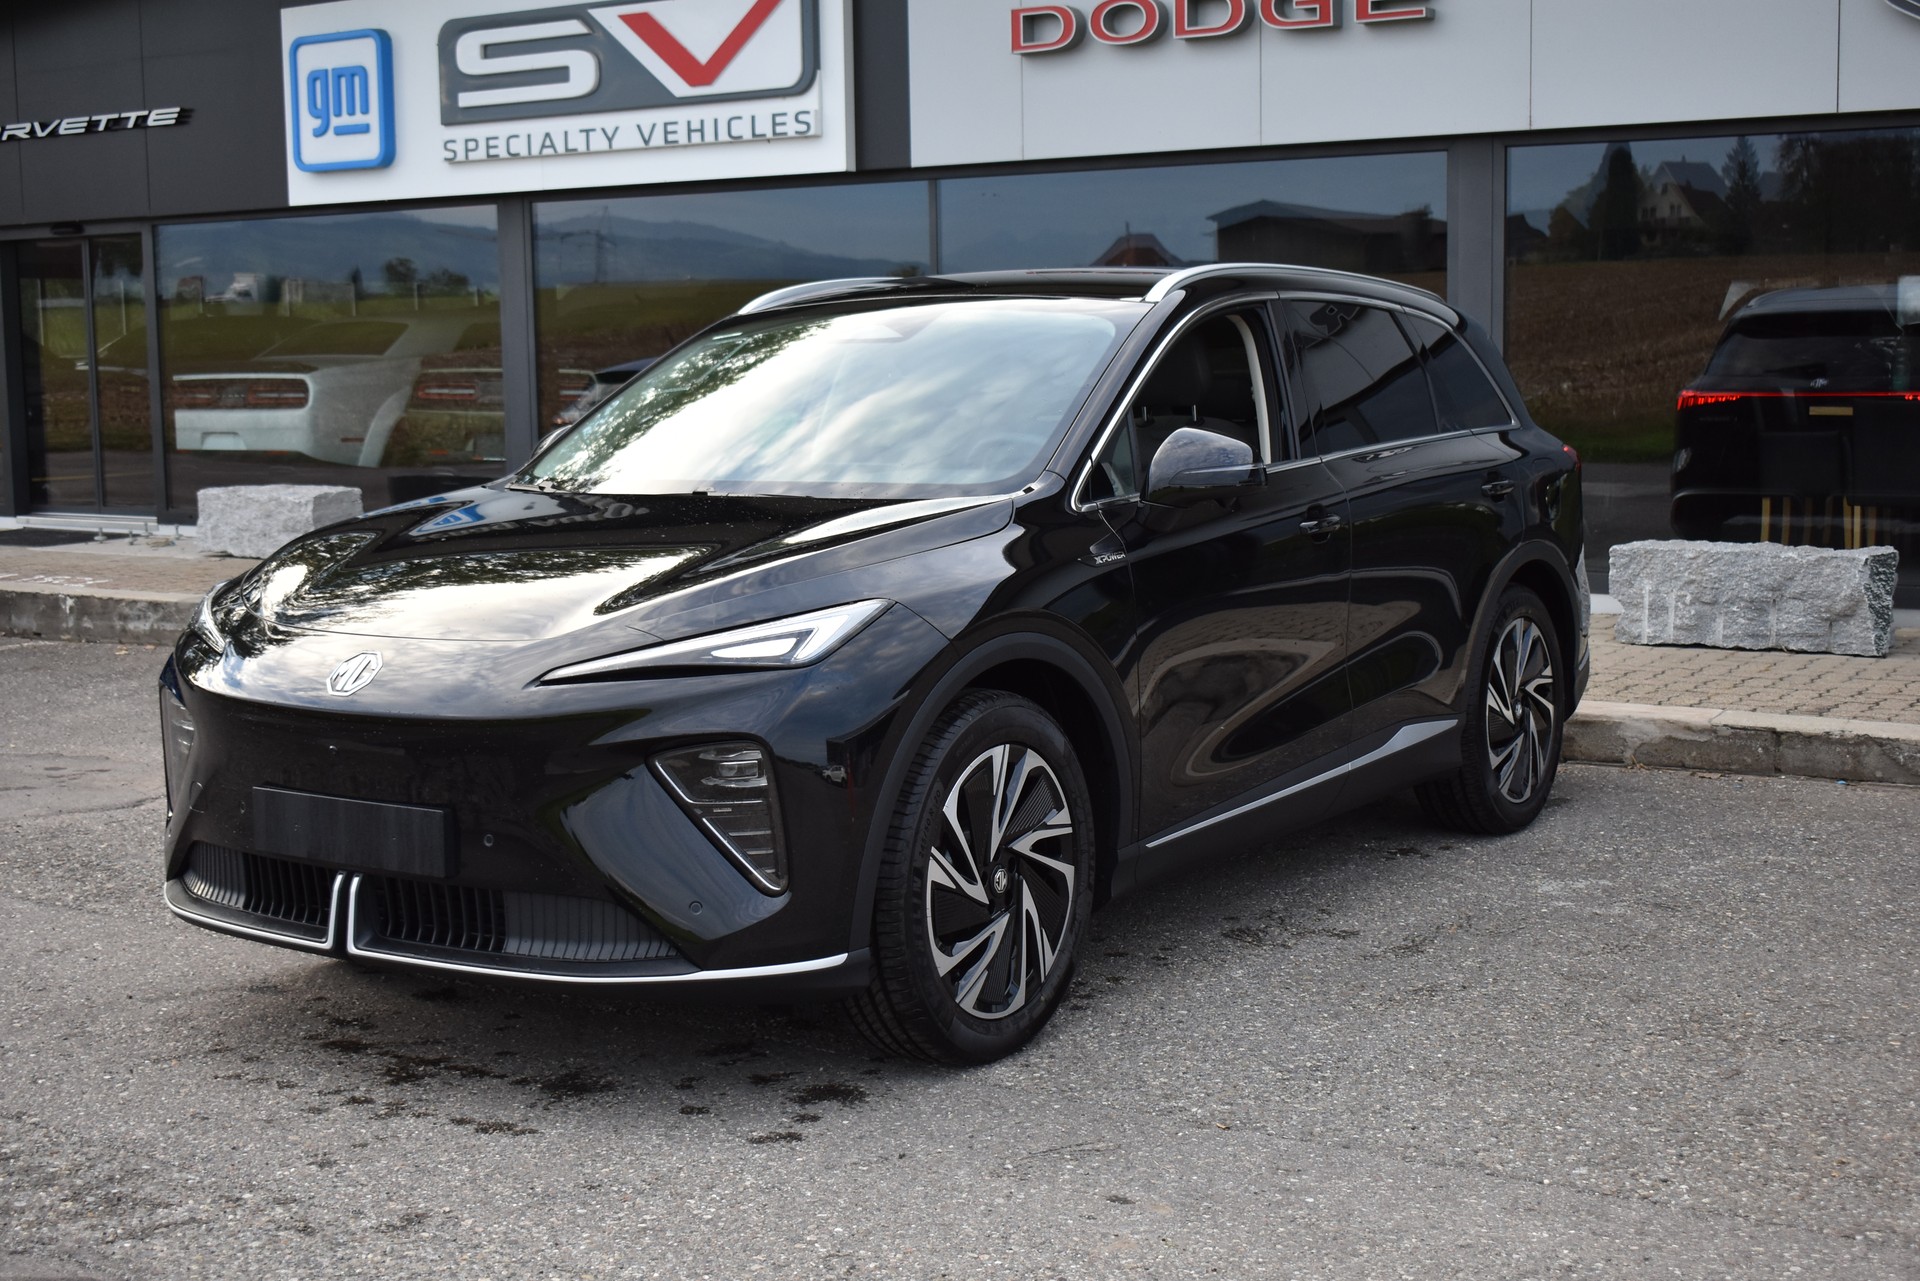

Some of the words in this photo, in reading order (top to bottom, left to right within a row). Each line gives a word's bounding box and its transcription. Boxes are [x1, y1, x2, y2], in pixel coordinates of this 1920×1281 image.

[0, 107, 181, 141] RVETTE
[307, 65, 370, 137] gm
[443, 126, 620, 162] SPECIALTY
[636, 110, 812, 147] VEHICLES
[330, 652, 379, 693] MG
